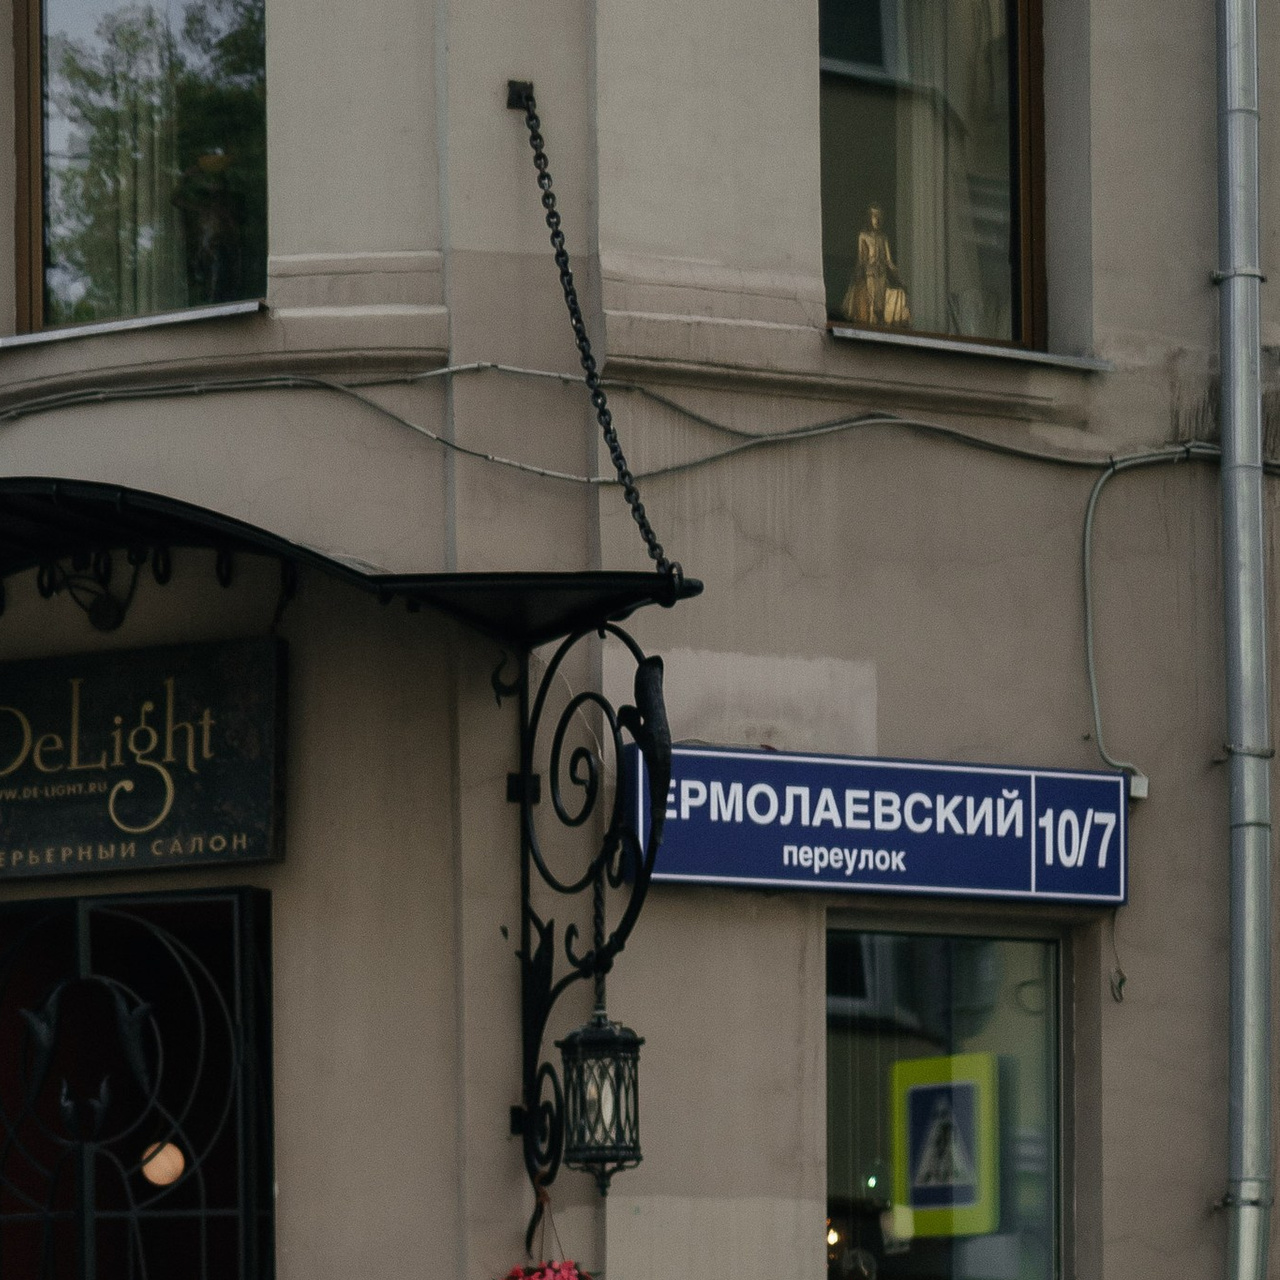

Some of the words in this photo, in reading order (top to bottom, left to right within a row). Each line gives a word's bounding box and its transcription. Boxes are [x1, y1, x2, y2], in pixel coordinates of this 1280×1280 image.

[151, 834, 248, 857] САЛОН
[1038, 808, 1116, 868] 10/7
[782, 845, 907, 875] переулок
